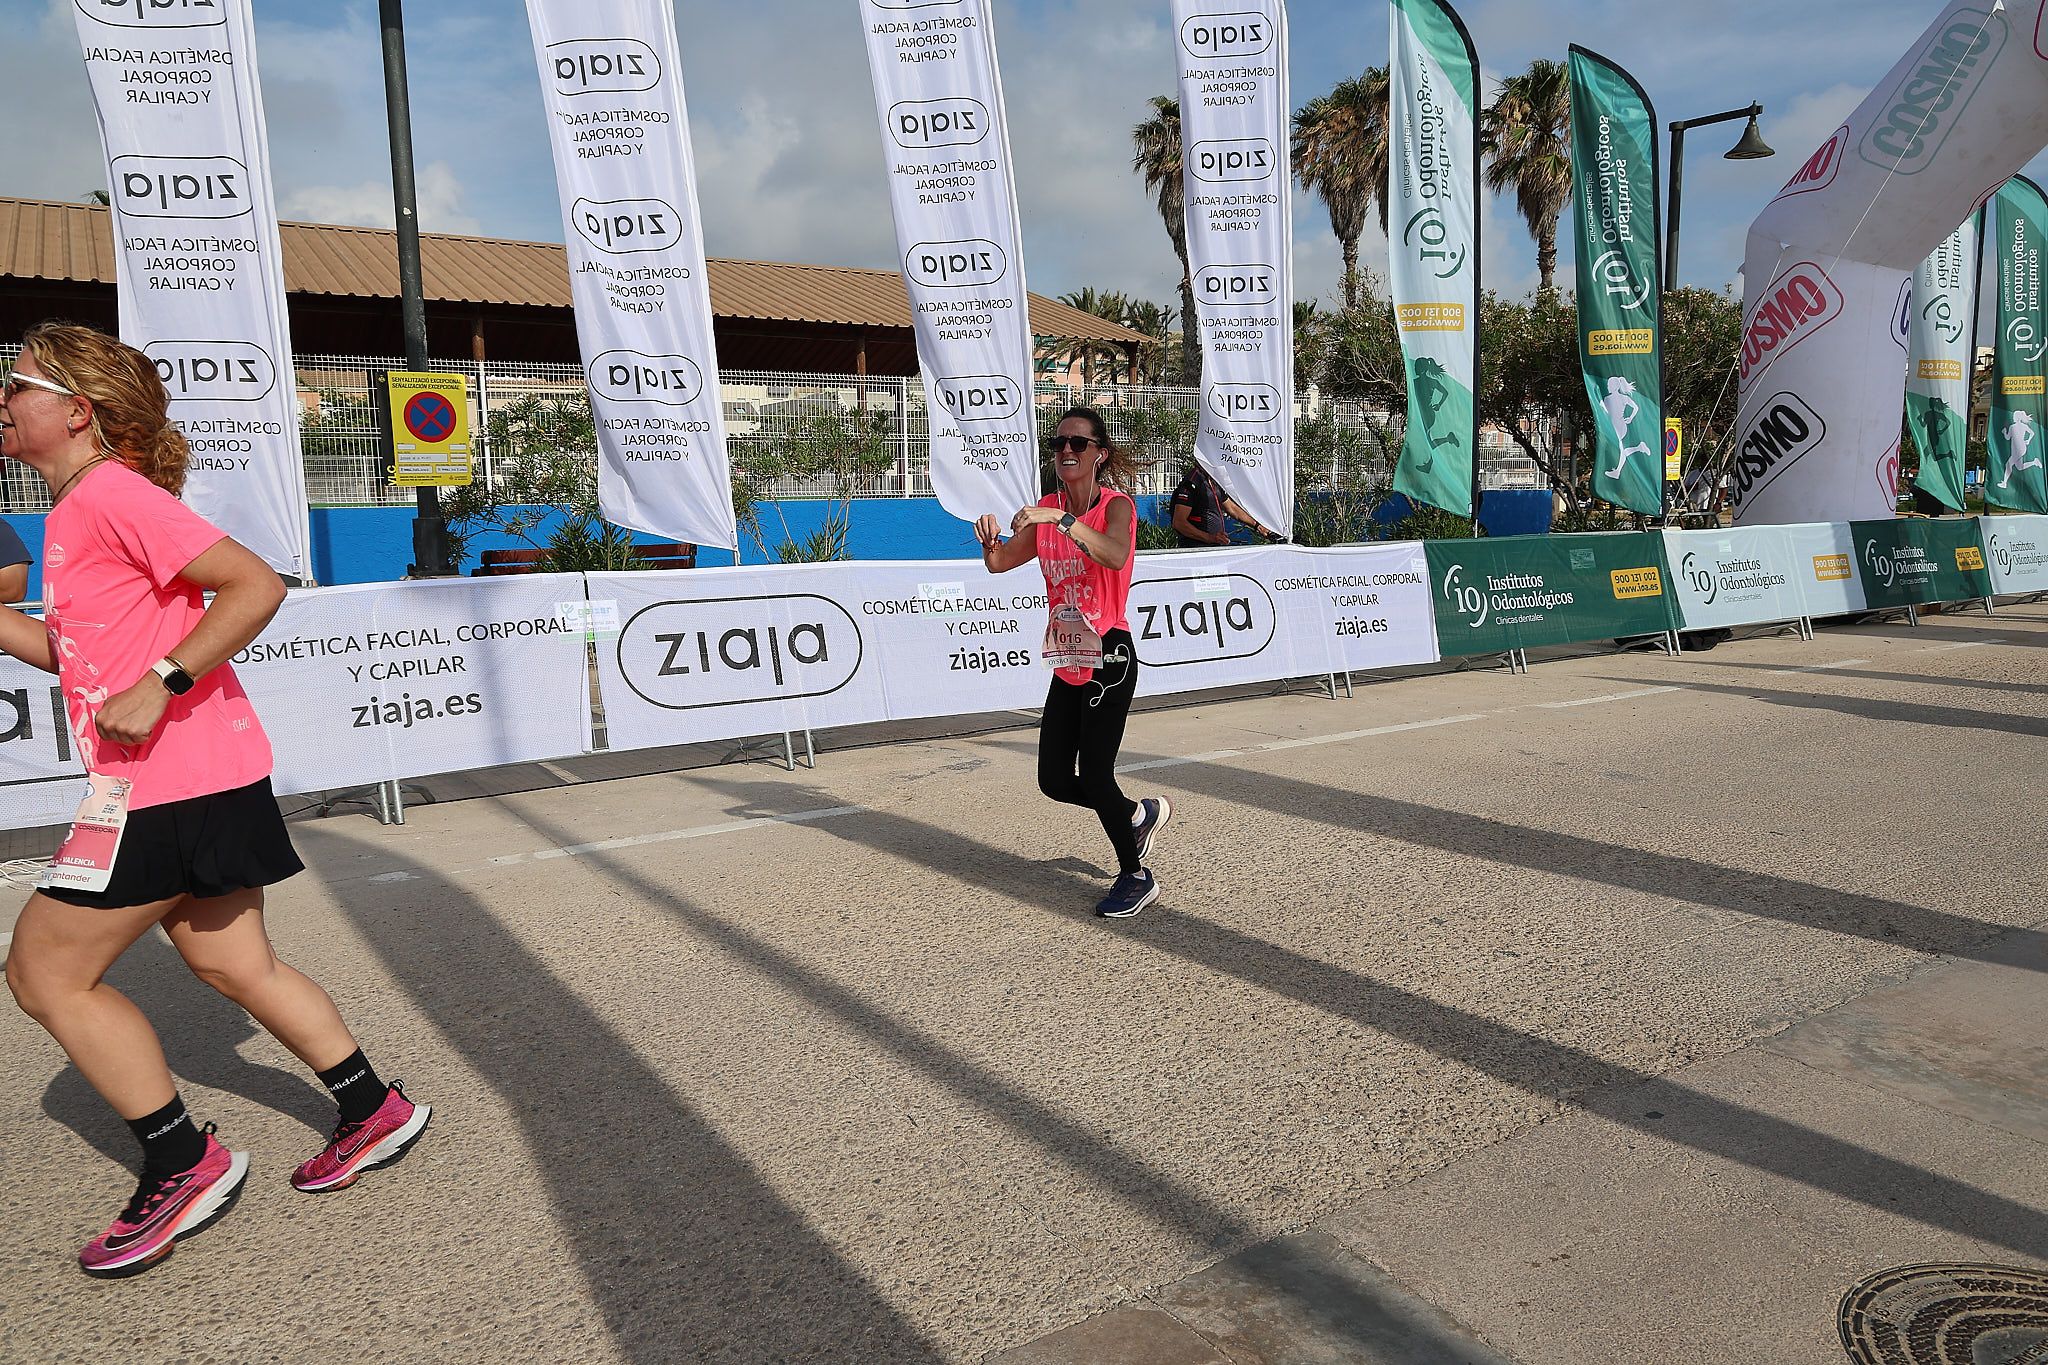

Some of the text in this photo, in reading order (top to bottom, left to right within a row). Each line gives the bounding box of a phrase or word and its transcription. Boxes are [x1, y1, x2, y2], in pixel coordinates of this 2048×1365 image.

[1873, 22, 1991, 160] COSMO
[1740, 275, 1827, 380] COSMO
[1716, 558, 1761, 574] Institutos
[1274, 572, 1422, 591] COSMÉTICA FACIAL, CORPORAL
[1486, 572, 1544, 592] Institutos
[1614, 572, 1656, 584] 900 131 002
[1616, 582, 1658, 594] www.ioa.es
[1720, 572, 1786, 590] Odontológicos
[862, 596, 1049, 614] COSMÉTICA FACIAL, CORP
[1332, 594, 1379, 608] Y CAPILAR
[1492, 589, 1574, 612] Odontológicos
[945, 620, 1020, 636] Y CAPILAR
[1137, 597, 1253, 648] ziaja
[1334, 616, 1388, 638] ziaja.es
[1518, 613, 1544, 624] dentales
[231, 616, 573, 664] OSMÉTICA FACIAL, CORPORAL
[654, 622, 828, 686] ziaja
[948, 646, 1031, 674] ziaja.es
[348, 656, 466, 683] Y CAPILAR
[351, 690, 482, 728] ziaja.es
[62, 856, 96, 867] VALENCIA
